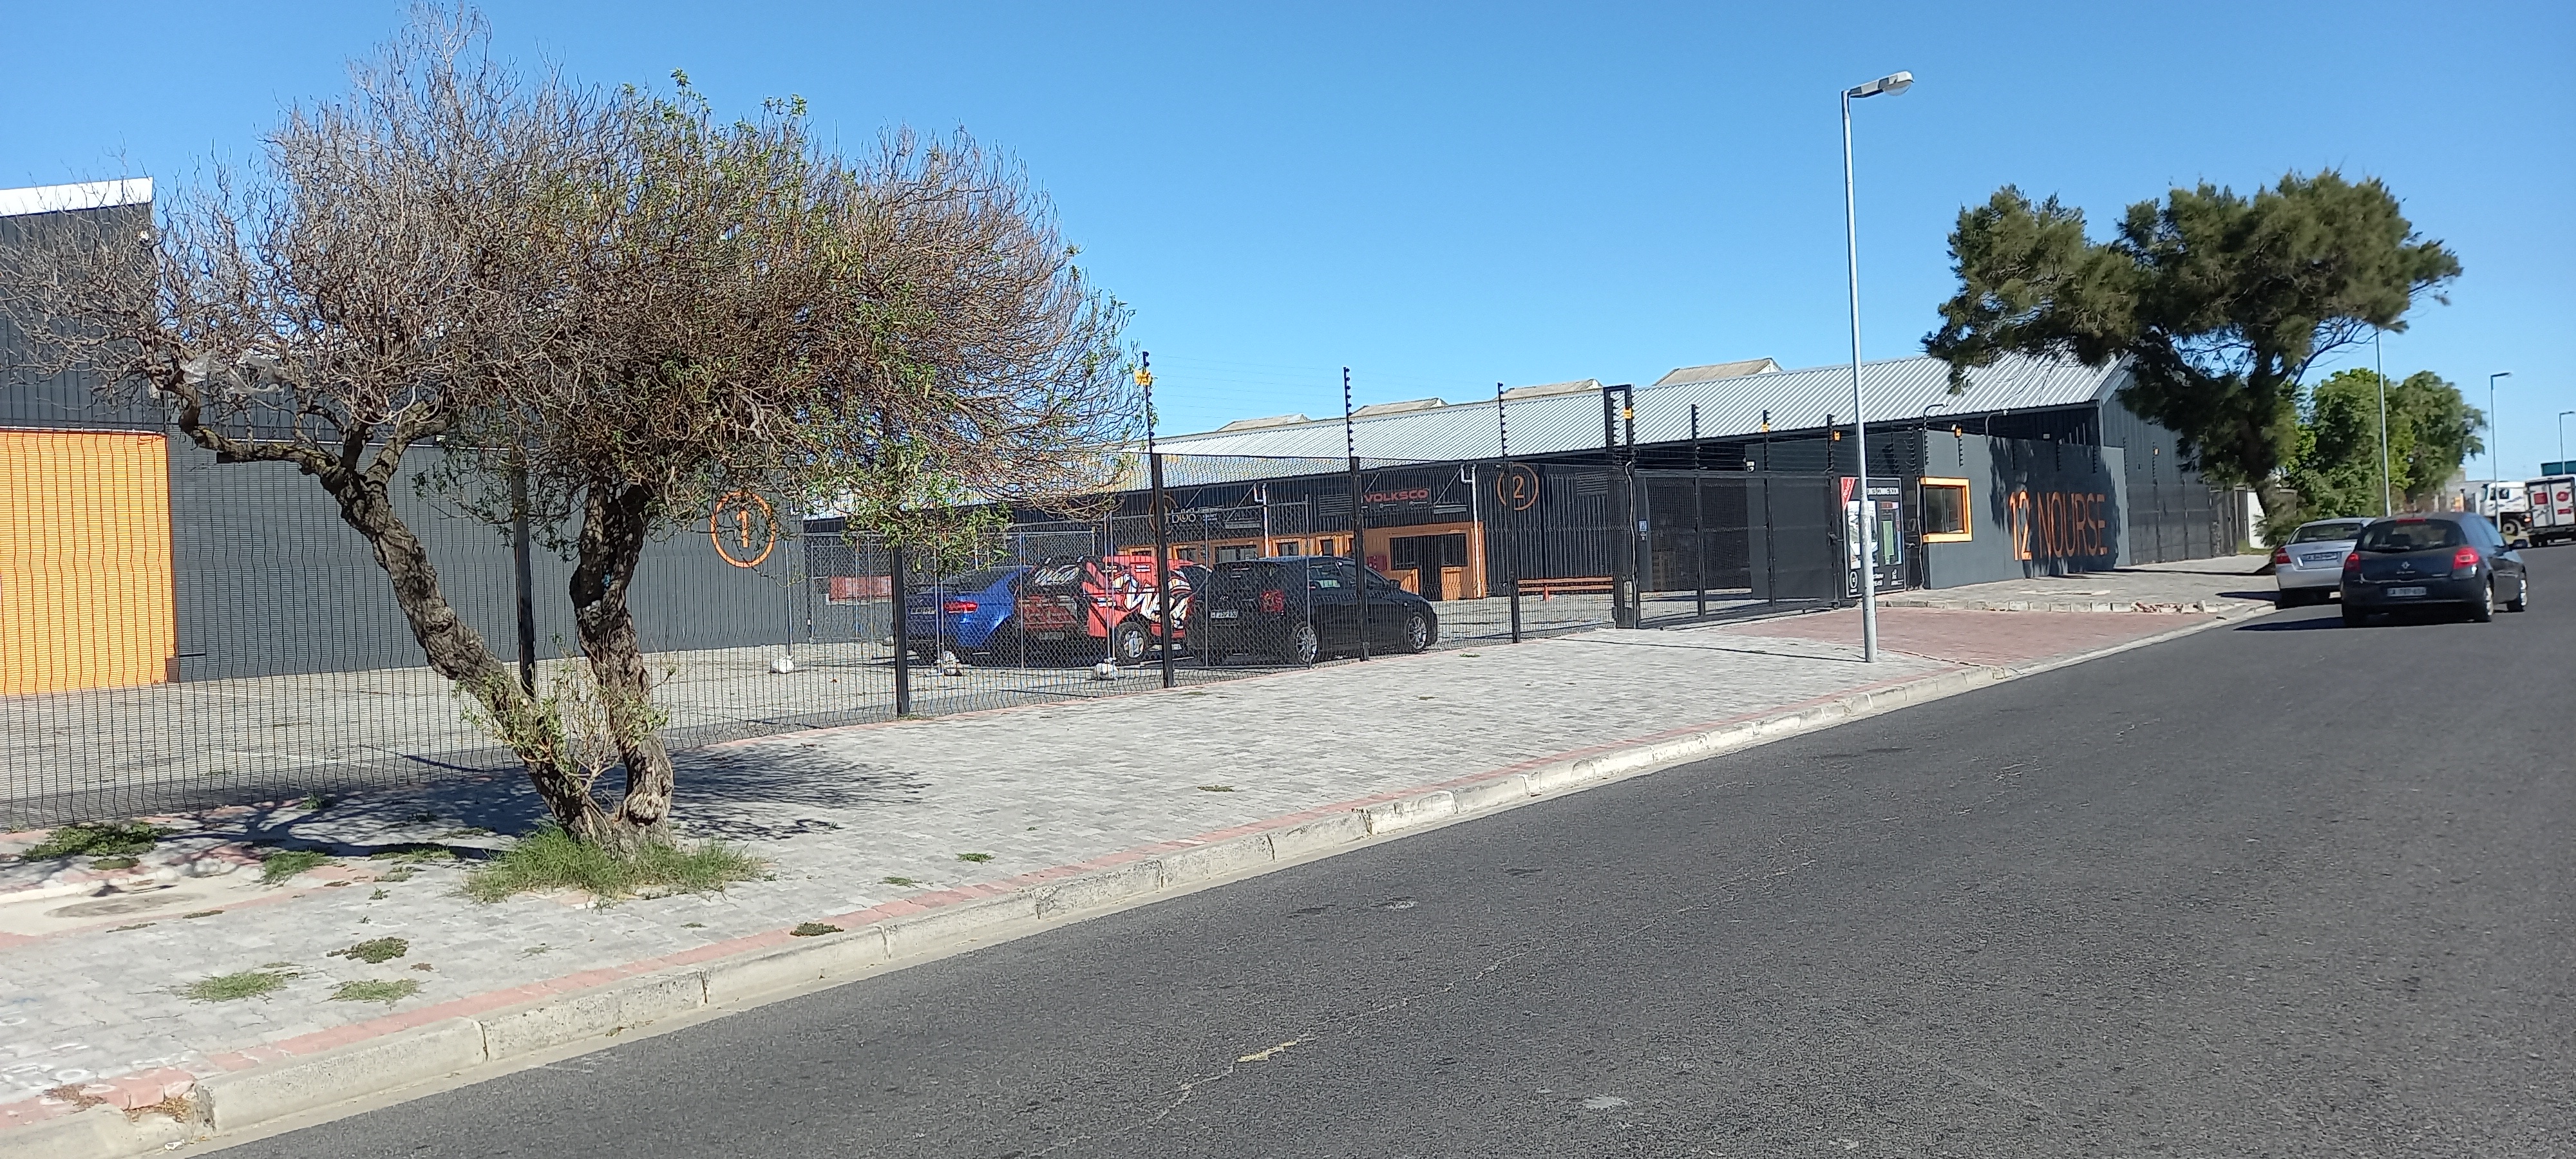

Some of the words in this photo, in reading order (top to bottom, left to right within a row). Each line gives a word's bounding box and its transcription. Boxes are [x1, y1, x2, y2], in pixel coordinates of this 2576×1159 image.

[1363, 489, 1428, 503] VOLKSCO
[1512, 475, 1525, 498] 2
[736, 509, 748, 548] 1
[2008, 491, 2032, 561] 12
[2037, 491, 2108, 558] NOURSE
